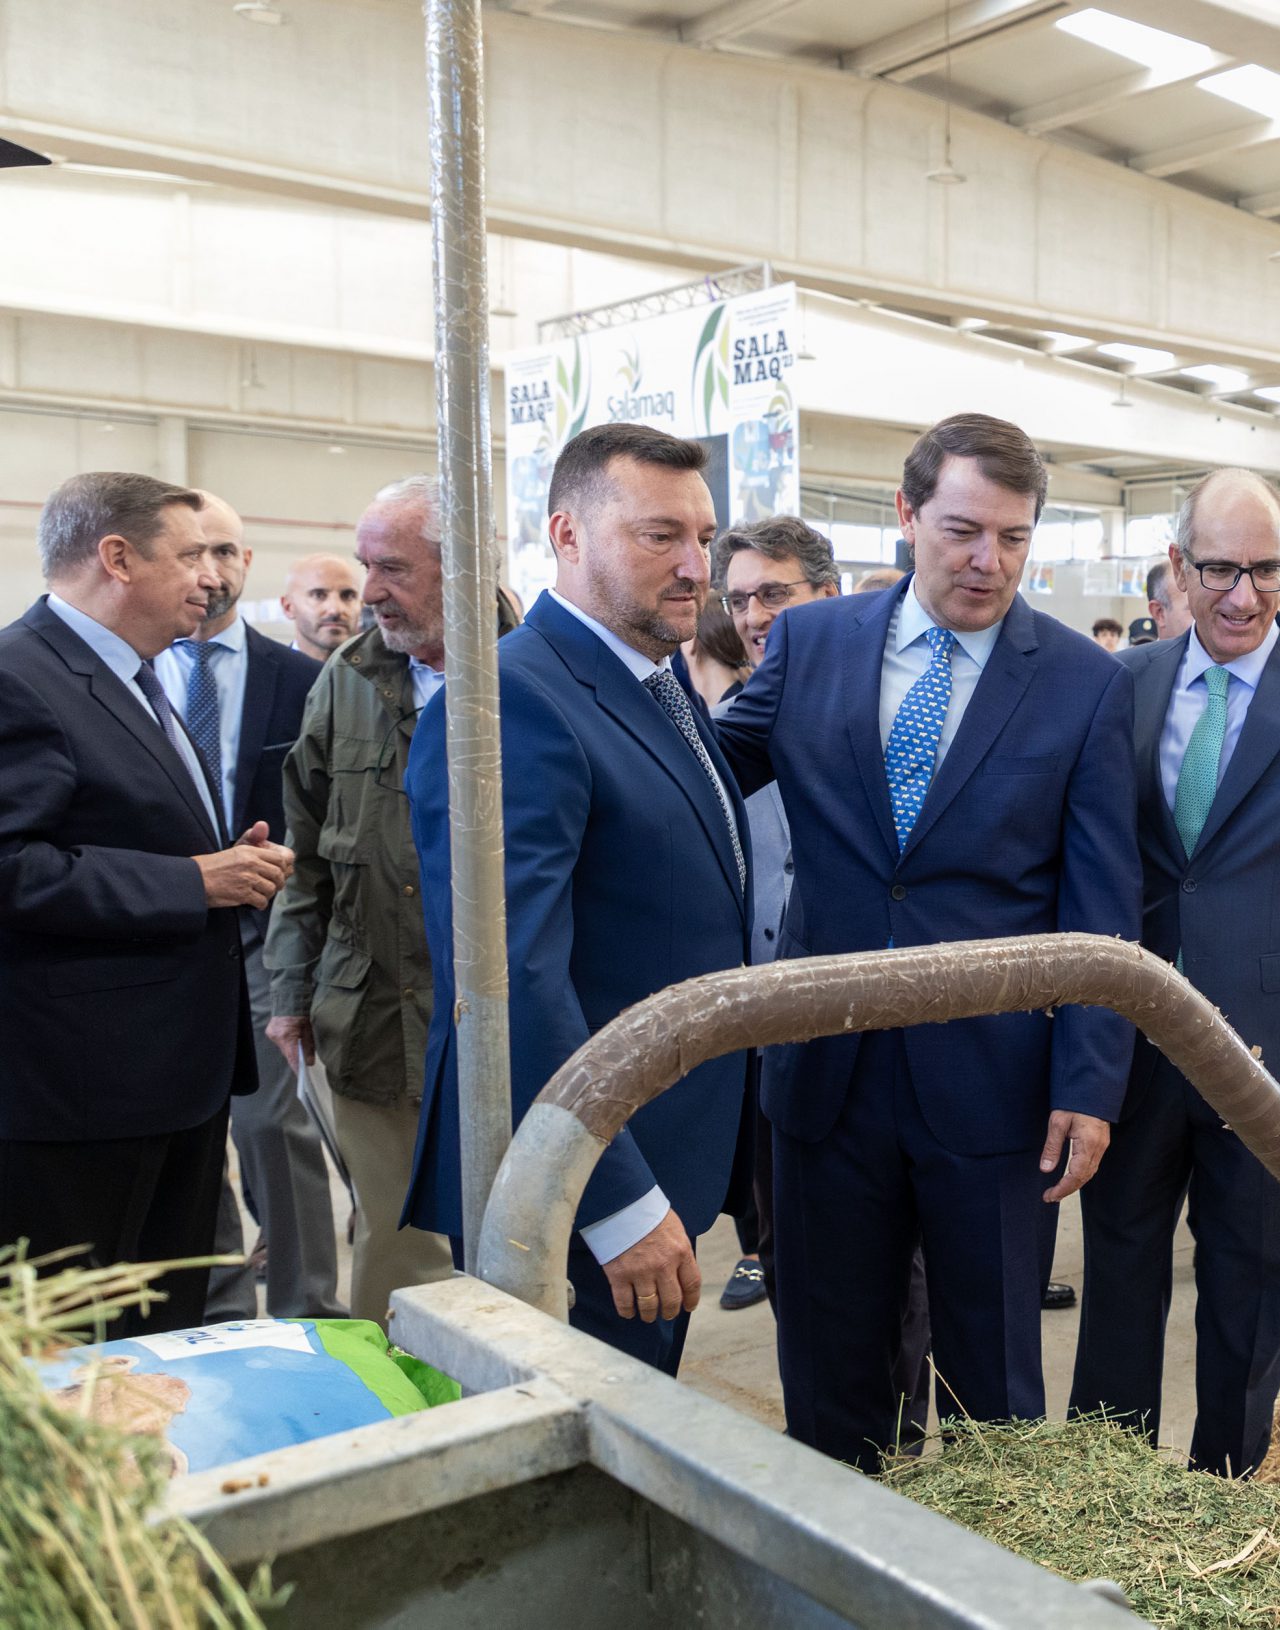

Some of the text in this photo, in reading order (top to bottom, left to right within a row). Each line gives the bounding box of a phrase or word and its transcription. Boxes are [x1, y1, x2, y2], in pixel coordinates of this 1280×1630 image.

[733, 329, 789, 361] SALA
[510, 380, 551, 404] SALA
[606, 390, 675, 423] Salamaq
